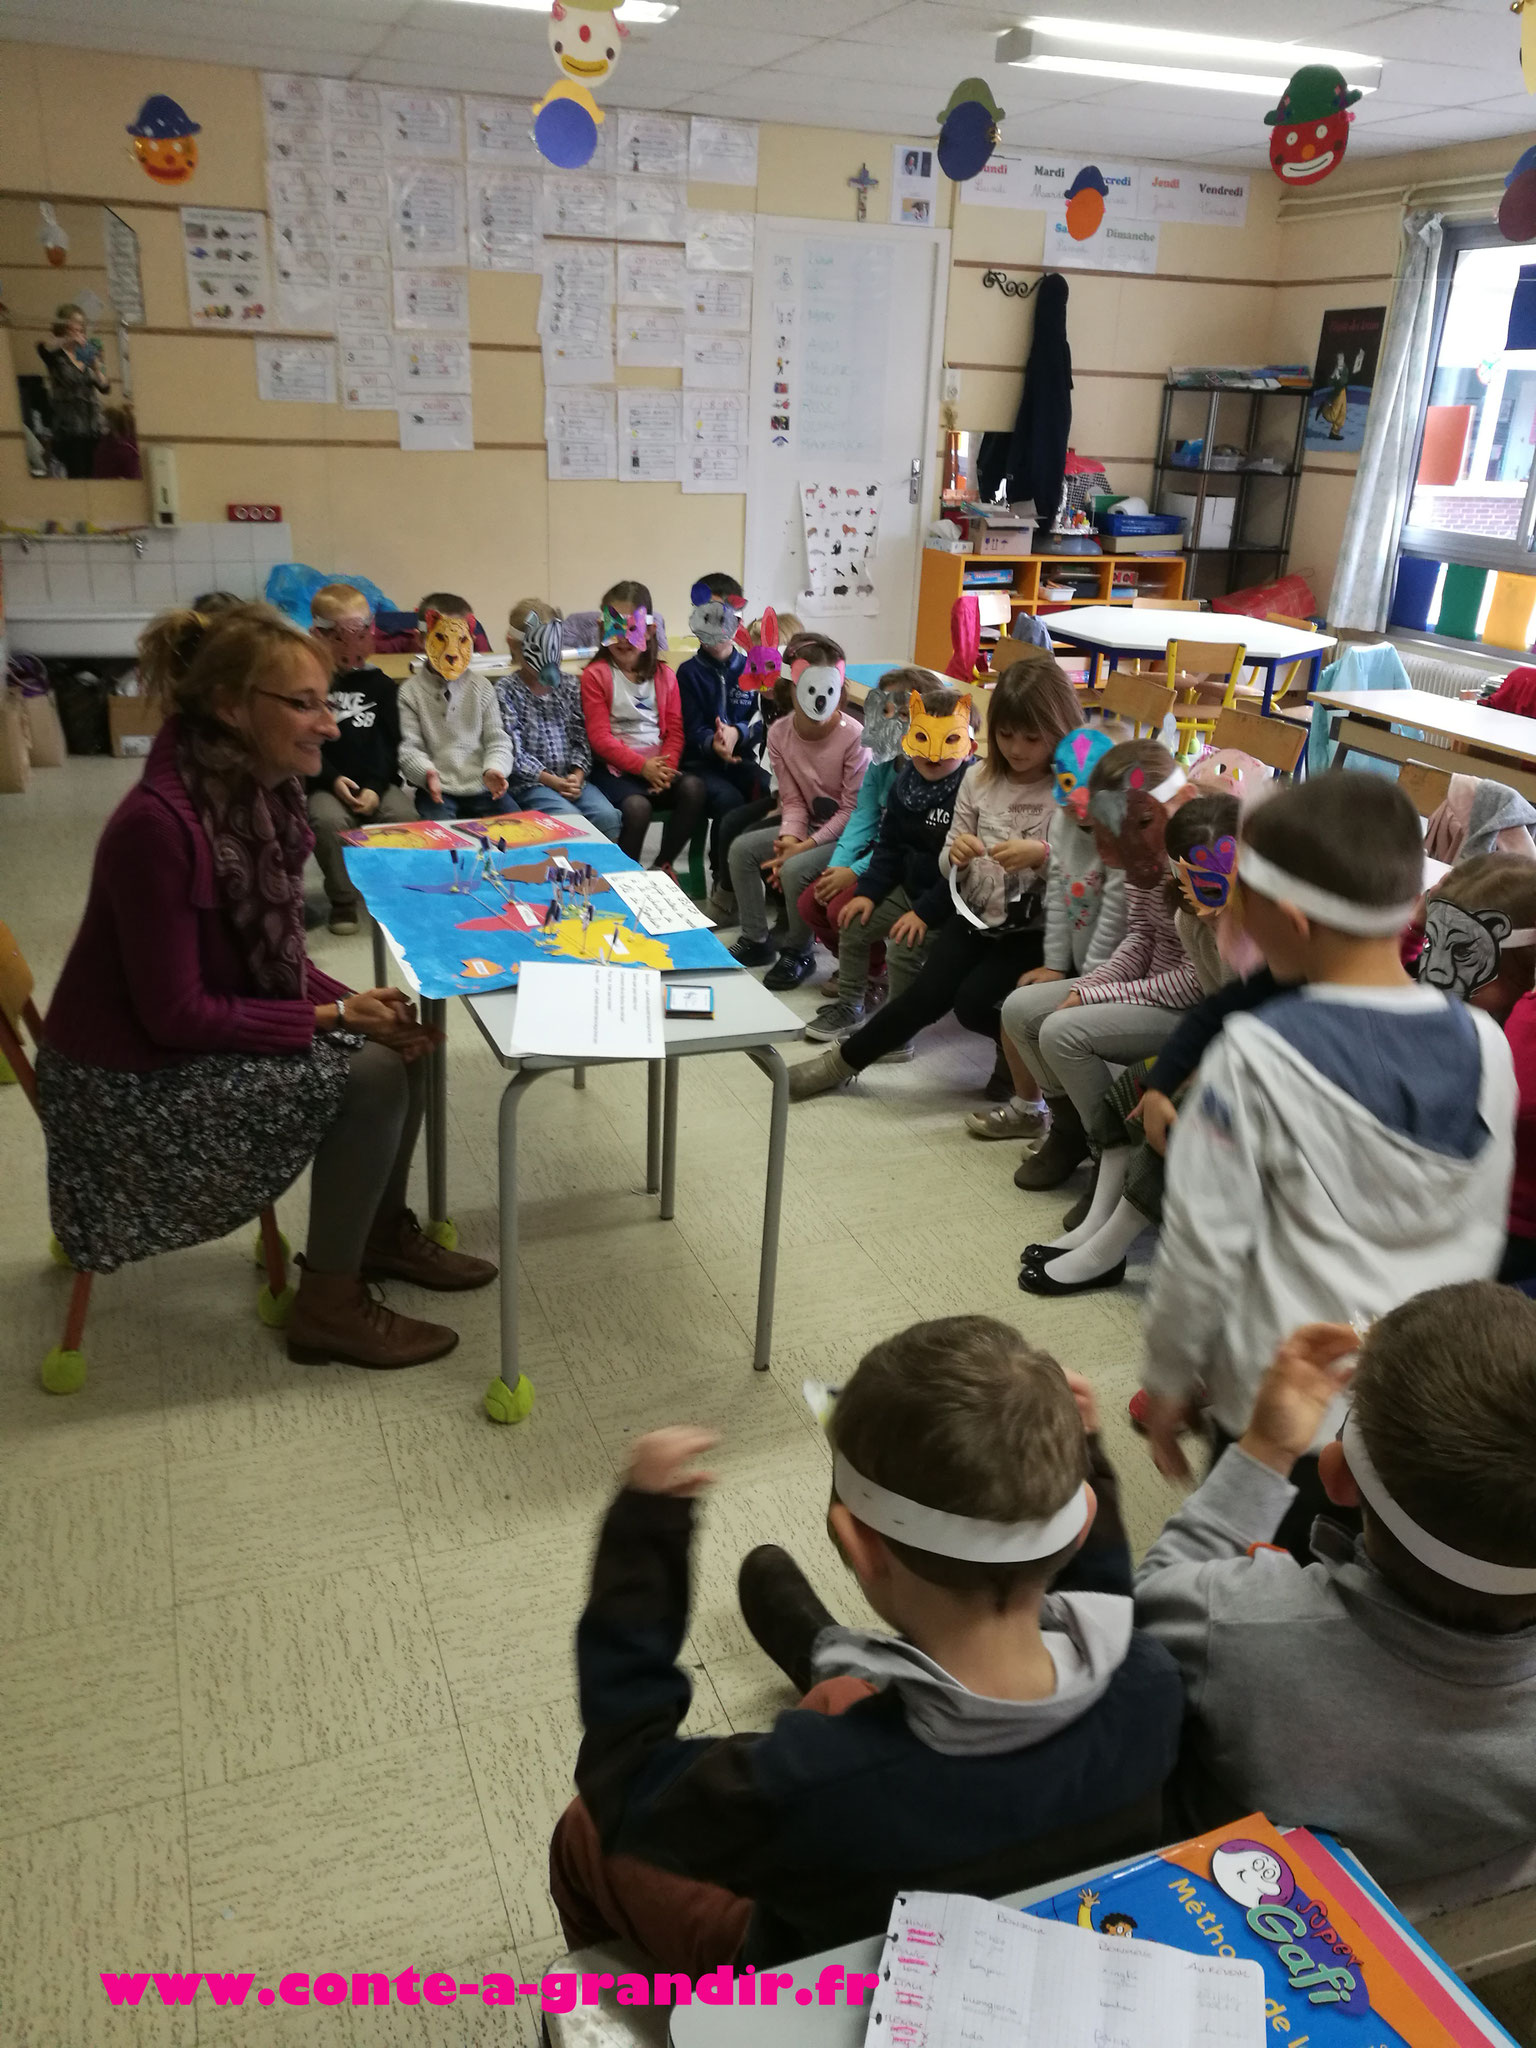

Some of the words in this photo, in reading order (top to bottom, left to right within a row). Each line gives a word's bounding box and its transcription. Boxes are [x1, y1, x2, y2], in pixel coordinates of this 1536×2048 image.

[982, 163, 1008, 175] undi
[1033, 165, 1065, 178] Mardi
[1151, 176, 1180, 189] Jeudi
[1198, 183, 1244, 197] Vendredi
[1105, 228, 1156, 242] Dimanche
[352, 711, 376, 728] SB
[1246, 1903, 1357, 2005] Gafi
[1265, 1997, 1291, 2033] de
